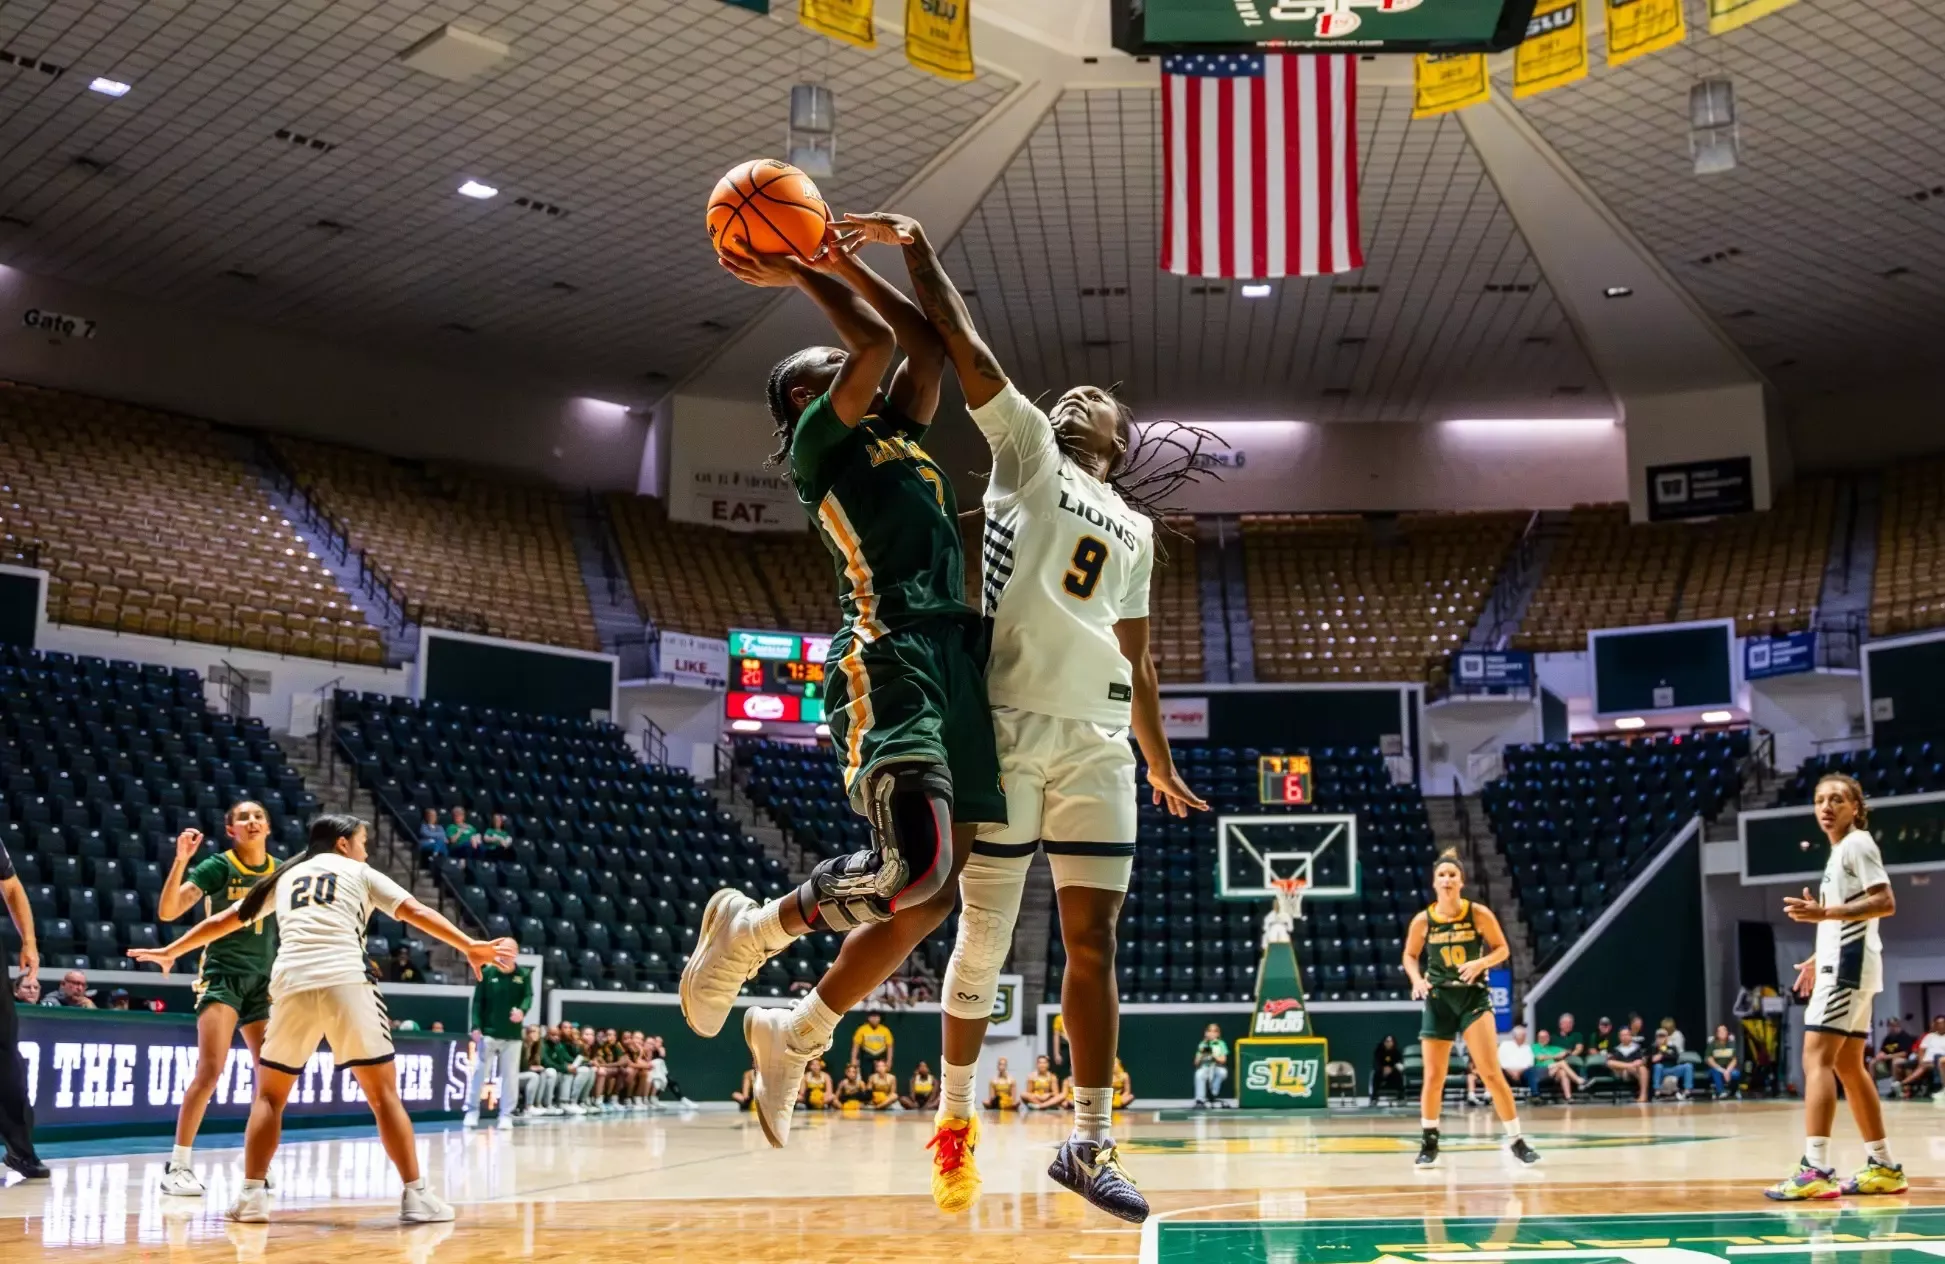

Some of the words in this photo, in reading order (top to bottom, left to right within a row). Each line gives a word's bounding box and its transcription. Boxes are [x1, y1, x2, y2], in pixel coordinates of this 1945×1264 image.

[1525, 6, 1575, 38] SLU
[83, 319, 97, 339] 7
[916, 465, 948, 517] 7
[1058, 489, 1136, 552] LIONS
[1061, 533, 1110, 601] 9
[1285, 775, 1303, 801] 6
[290, 872, 337, 910] 20
[1440, 944, 1467, 968] 10
[53, 1042, 137, 1108] THE
[342, 1053, 433, 1102] CTER
[1246, 1057, 1319, 1098] SLU
